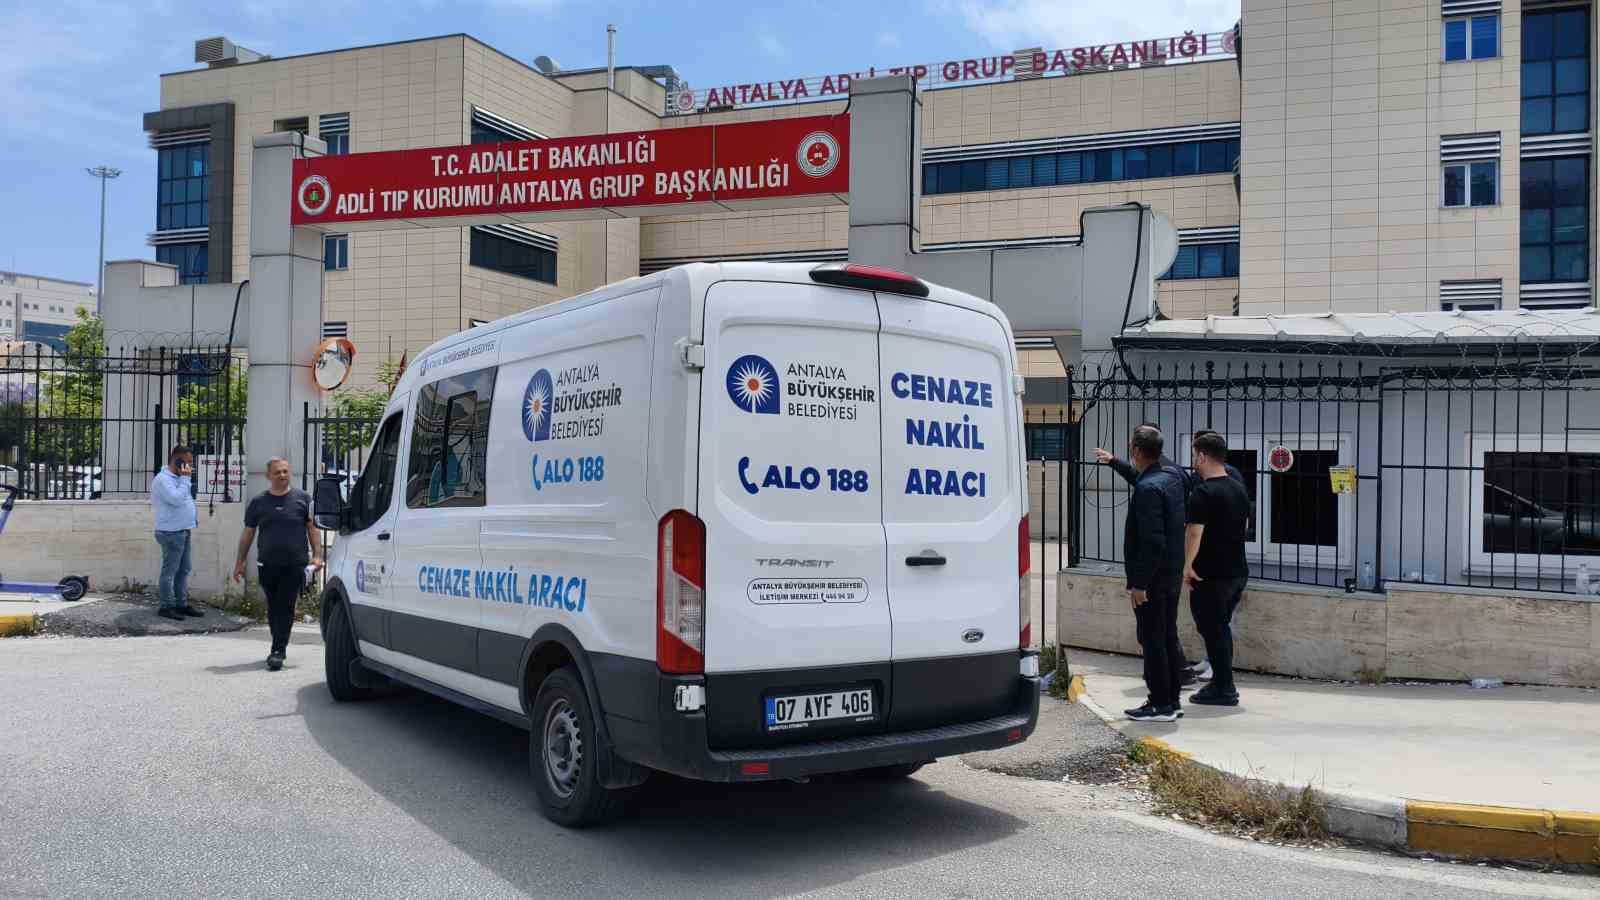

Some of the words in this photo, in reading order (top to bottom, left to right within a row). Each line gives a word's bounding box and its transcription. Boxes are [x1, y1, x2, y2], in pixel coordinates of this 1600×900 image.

[706, 79, 808, 107] ANTALYA
[820, 67, 875, 95] AD
[942, 55, 1016, 81] GRUP
[1032, 30, 1207, 73] BAŞKANLIĞI
[431, 155, 464, 177] T.C.
[468, 148, 542, 174] ADALET
[549, 135, 656, 169] BAKANLIĞI
[335, 188, 374, 215] ADLİ
[380, 190, 409, 212] TIP
[413, 184, 493, 210] KURUMU
[499, 178, 583, 205] ANTALYA
[590, 174, 645, 200] GRUP
[655, 158, 789, 200] BAŞKANLIĞI
[556, 361, 600, 386] ANTALYA
[787, 362, 847, 381] ANTALYA
[553, 382, 622, 416] BÜYÜKŞEHİR
[787, 380, 875, 403] BÜYÜKŞEHİR
[891, 372, 993, 408] CENAZE
[787, 403, 857, 421] BELEDİYESİ
[551, 414, 604, 440] BELEDİYESİ
[906, 414, 985, 450] NAKİL
[543, 459, 574, 484] ALO
[577, 455, 605, 482] 188
[761, 465, 820, 490] ALO
[827, 468, 869, 493] 188
[904, 468, 986, 498] ARACI
[755, 558, 835, 568] TRANSIT
[417, 565, 471, 599] CENAZE
[474, 564, 524, 604] NAKİL
[527, 573, 587, 612] ARACI
[776, 699, 796, 721] 07
[804, 695, 833, 719] AYF
[841, 692, 869, 715] 406
